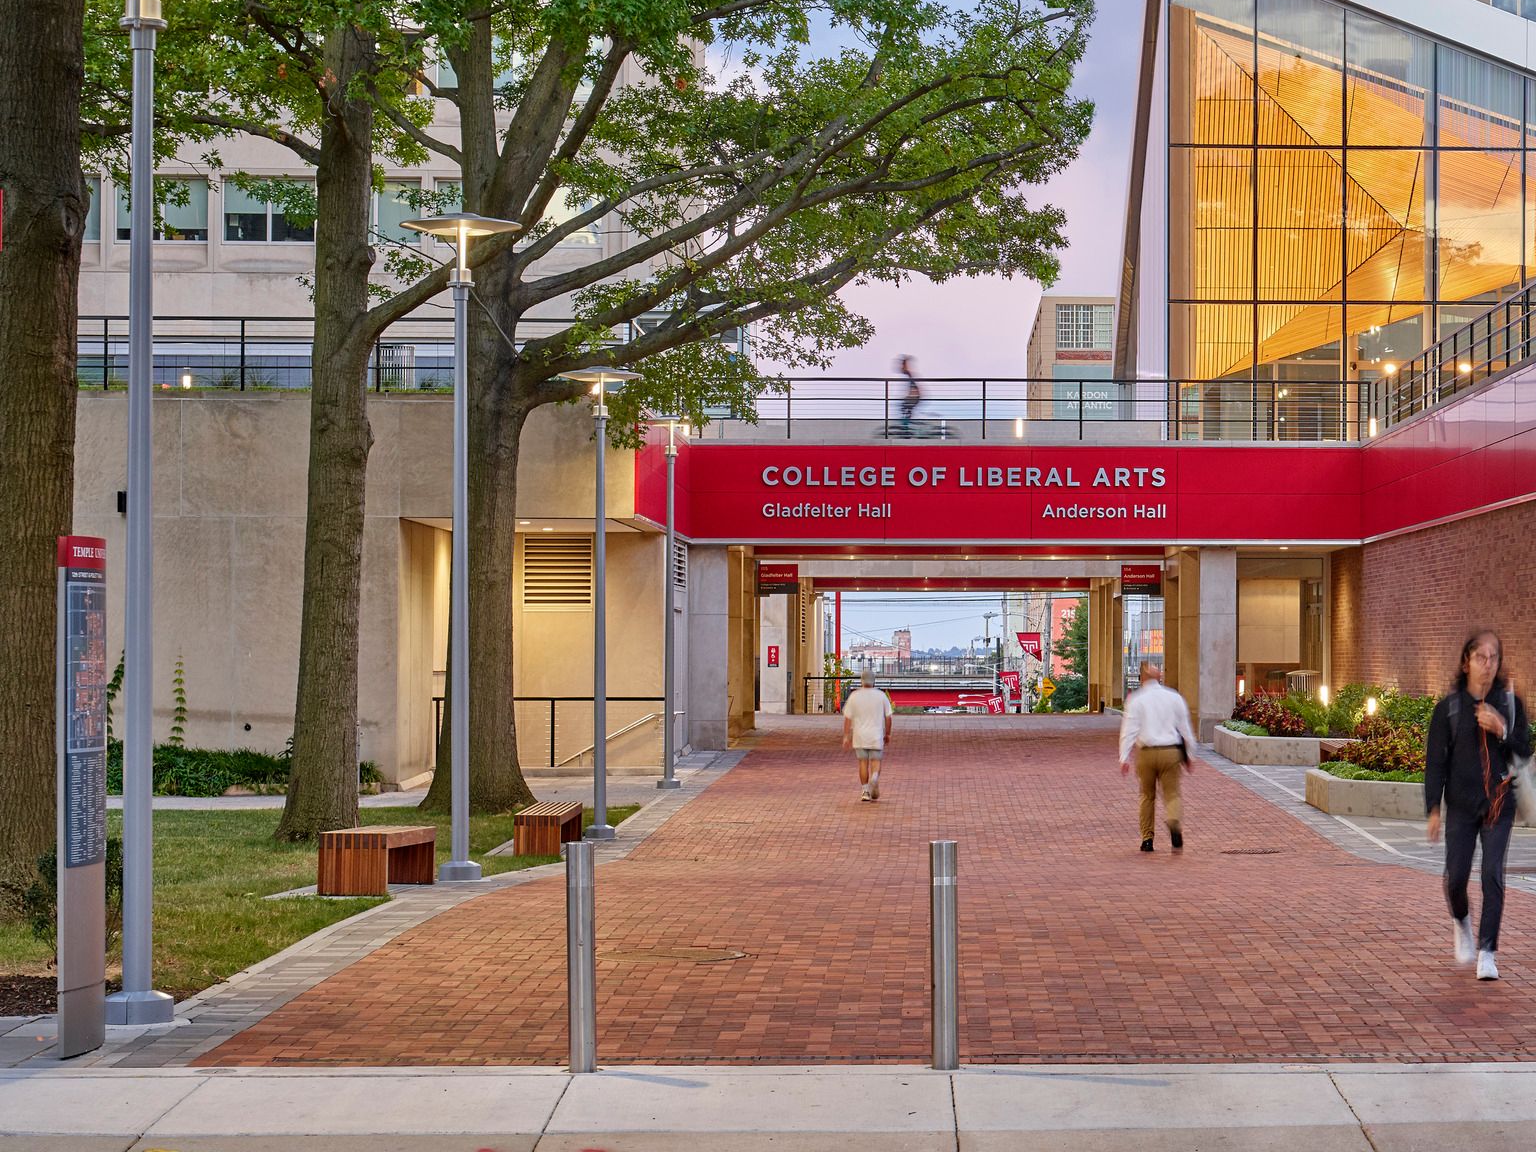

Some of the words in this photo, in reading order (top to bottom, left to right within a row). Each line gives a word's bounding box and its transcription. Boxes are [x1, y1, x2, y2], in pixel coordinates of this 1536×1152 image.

[762, 465, 896, 486] COLLEGE
[908, 466, 947, 487] OF
[958, 467, 1081, 487] LIBERAL
[1092, 467, 1166, 487] ARTS
[762, 503, 851, 518] Gladfelter
[858, 503, 892, 518] Hall
[1042, 504, 1127, 519] Anderson
[1134, 504, 1167, 519] Hall
[73, 546, 94, 558] TEMPLE
